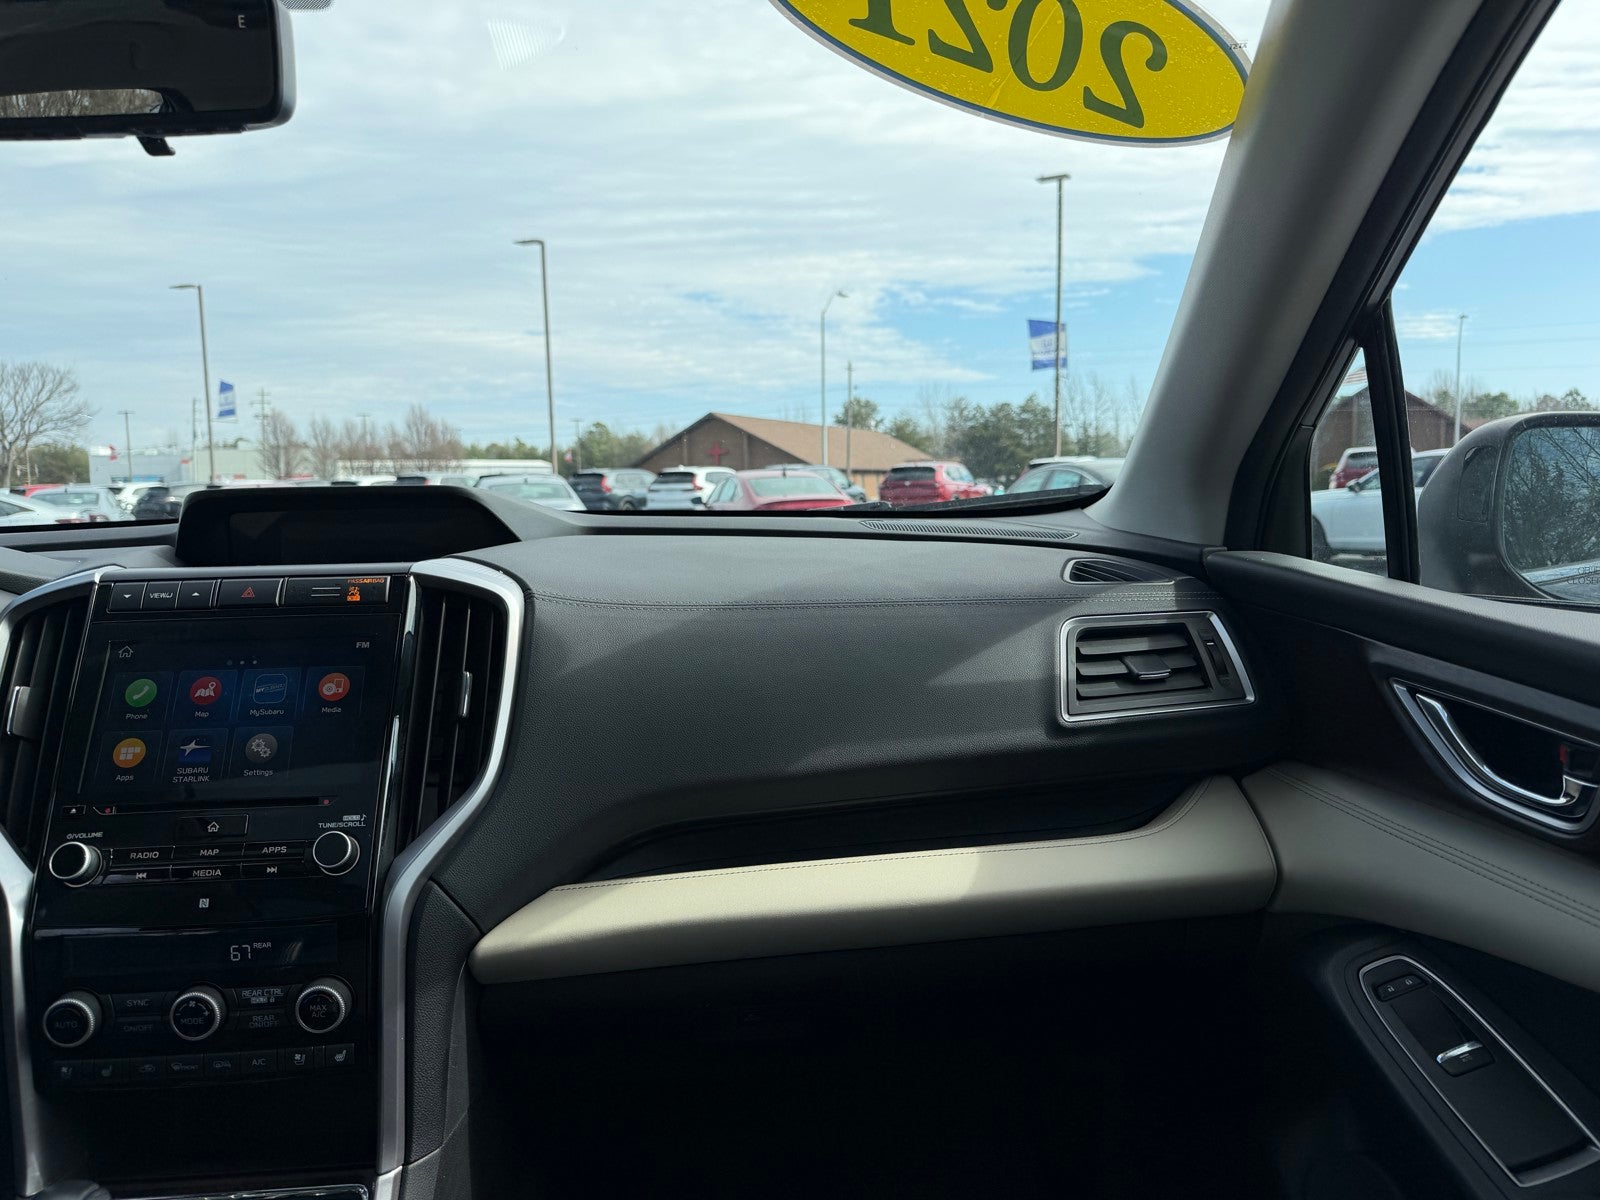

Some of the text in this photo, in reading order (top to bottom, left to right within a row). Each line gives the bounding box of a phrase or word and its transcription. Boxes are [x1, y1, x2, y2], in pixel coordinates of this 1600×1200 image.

[238, 14, 246, 28] E
[355, 641, 370, 649] FM
[194, 711, 209, 719] Map
[249, 708, 285, 717] MySubaru
[176, 766, 209, 774] SUBARU
[243, 768, 274, 777] Settings
[115, 774, 135, 782] Apps
[172, 775, 210, 783] STARLINK
[199, 848, 220, 856] MAP
[261, 846, 287, 854] APPS
[130, 851, 159, 859] RADIO
[192, 869, 222, 877] MEDIA
[230, 944, 251, 962] 67
[241, 988, 284, 997] REAR CTRL
[127, 999, 152, 1007] SYNC
[54, 1021, 78, 1029] AUTO
[180, 1017, 206, 1025] MODE
[251, 1058, 267, 1066] A/C
